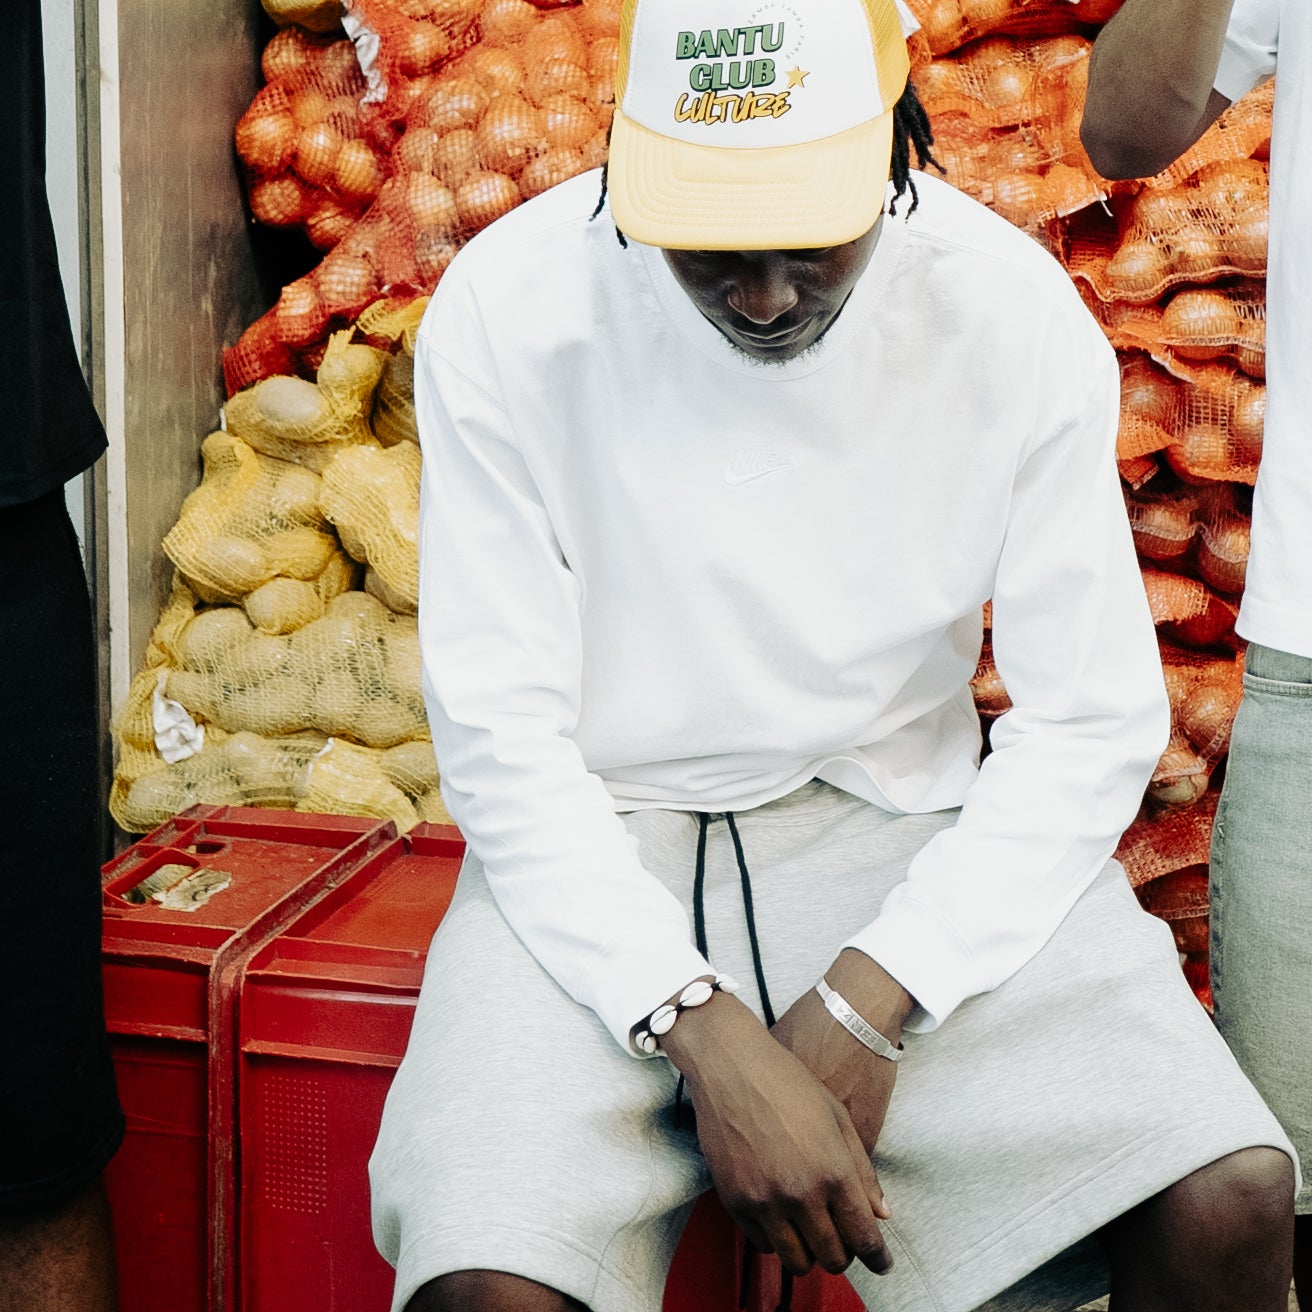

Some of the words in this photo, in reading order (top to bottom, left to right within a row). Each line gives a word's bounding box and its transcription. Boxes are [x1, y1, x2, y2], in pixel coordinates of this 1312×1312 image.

[676, 22, 785, 60] BANTU
[689, 58, 776, 92] CLUB
[674, 90, 791, 126] CULTURE
